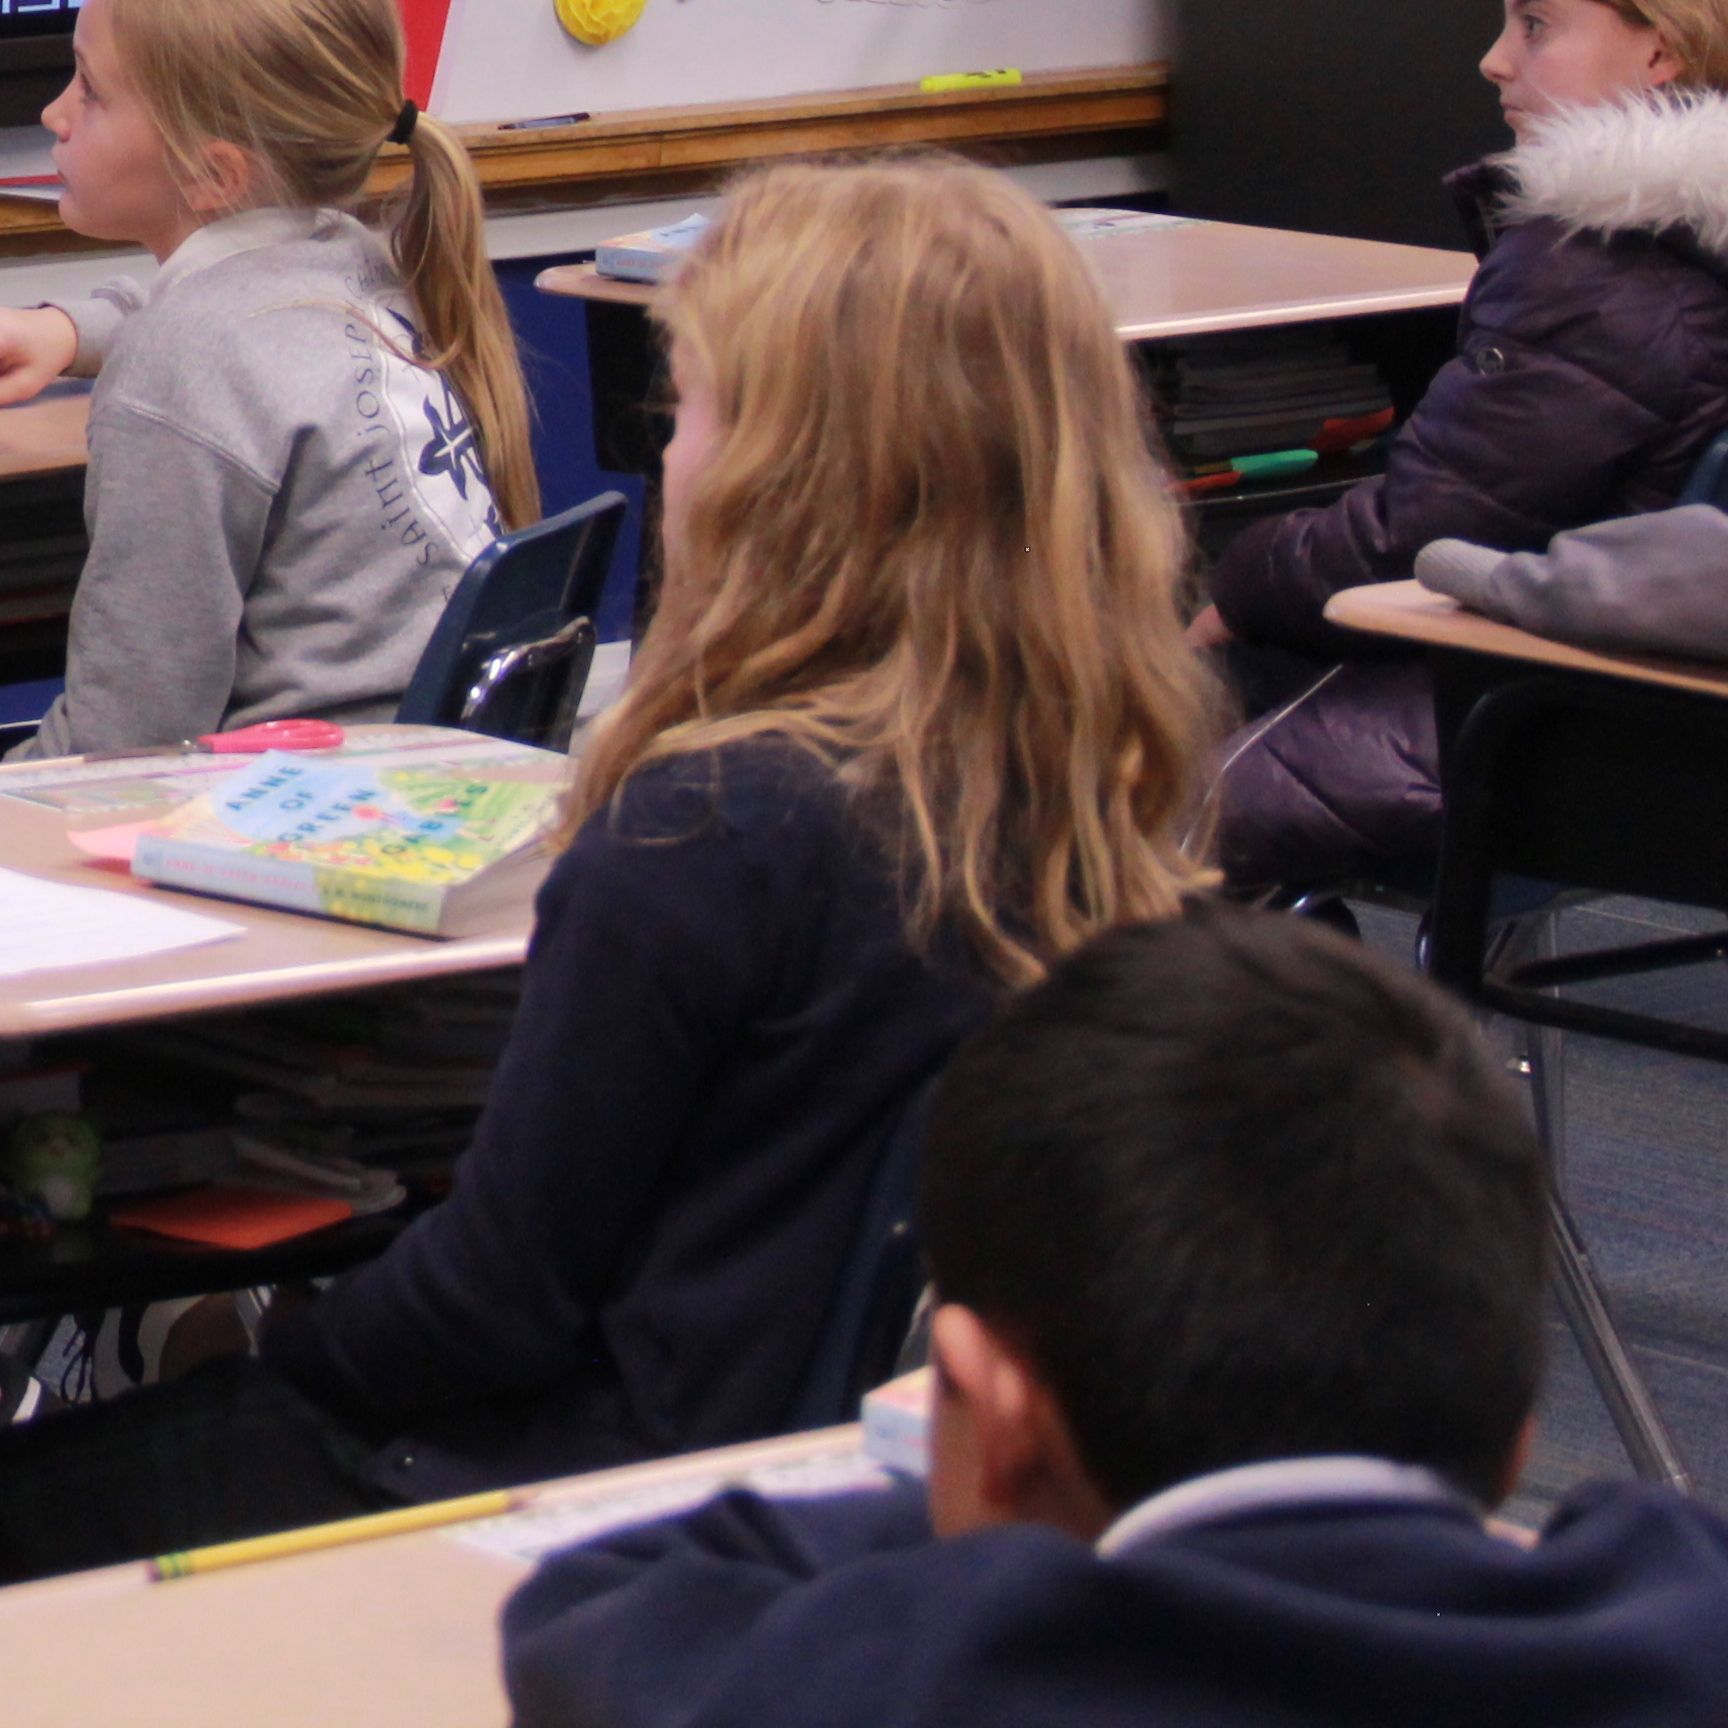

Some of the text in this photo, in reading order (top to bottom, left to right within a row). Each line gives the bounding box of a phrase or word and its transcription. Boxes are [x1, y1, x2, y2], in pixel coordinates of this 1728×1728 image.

[226, 764, 304, 812] ANNE
[280, 789, 314, 812] OF
[277, 788, 377, 843] GREEN
